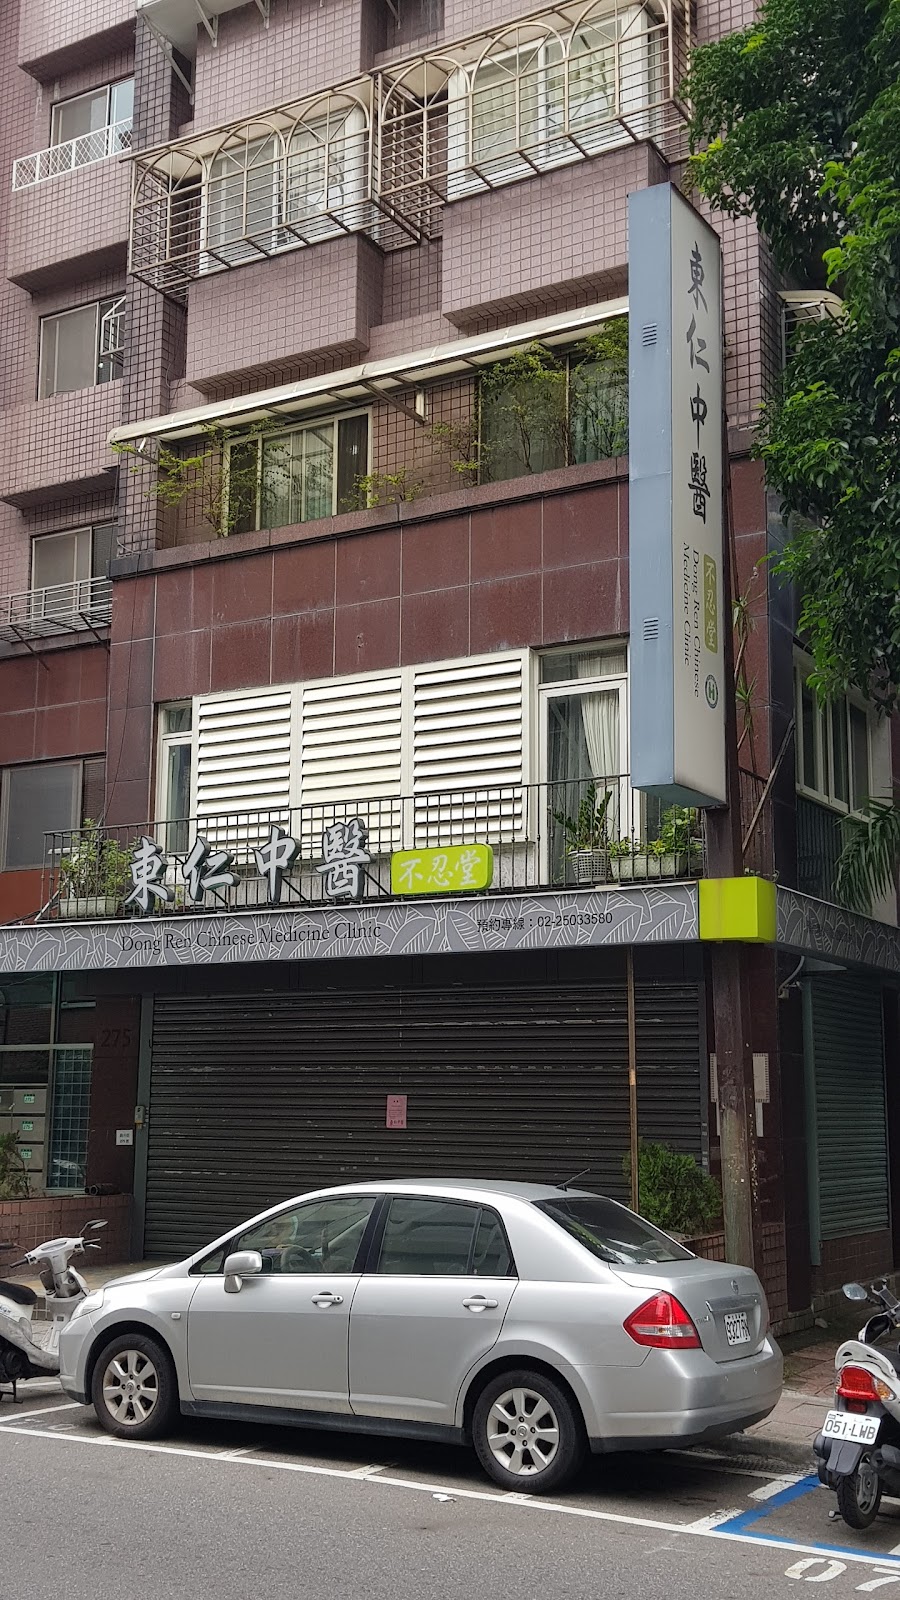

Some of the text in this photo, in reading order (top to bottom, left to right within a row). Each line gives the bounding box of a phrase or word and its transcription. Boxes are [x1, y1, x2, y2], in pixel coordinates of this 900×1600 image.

[686, 240, 711, 525] 東仁中醫
[683, 542, 692, 666] Medicine Clinic
[691, 548, 701, 698] Dong Ren Chinese
[705, 561, 716, 648] 不忍堂
[124, 817, 375, 912] 東仁中醫
[398, 850, 481, 890] 不忍堂
[121, 922, 382, 956] Dong Ren Chinese Medicine Clinic
[102, 1029, 132, 1048] 275
